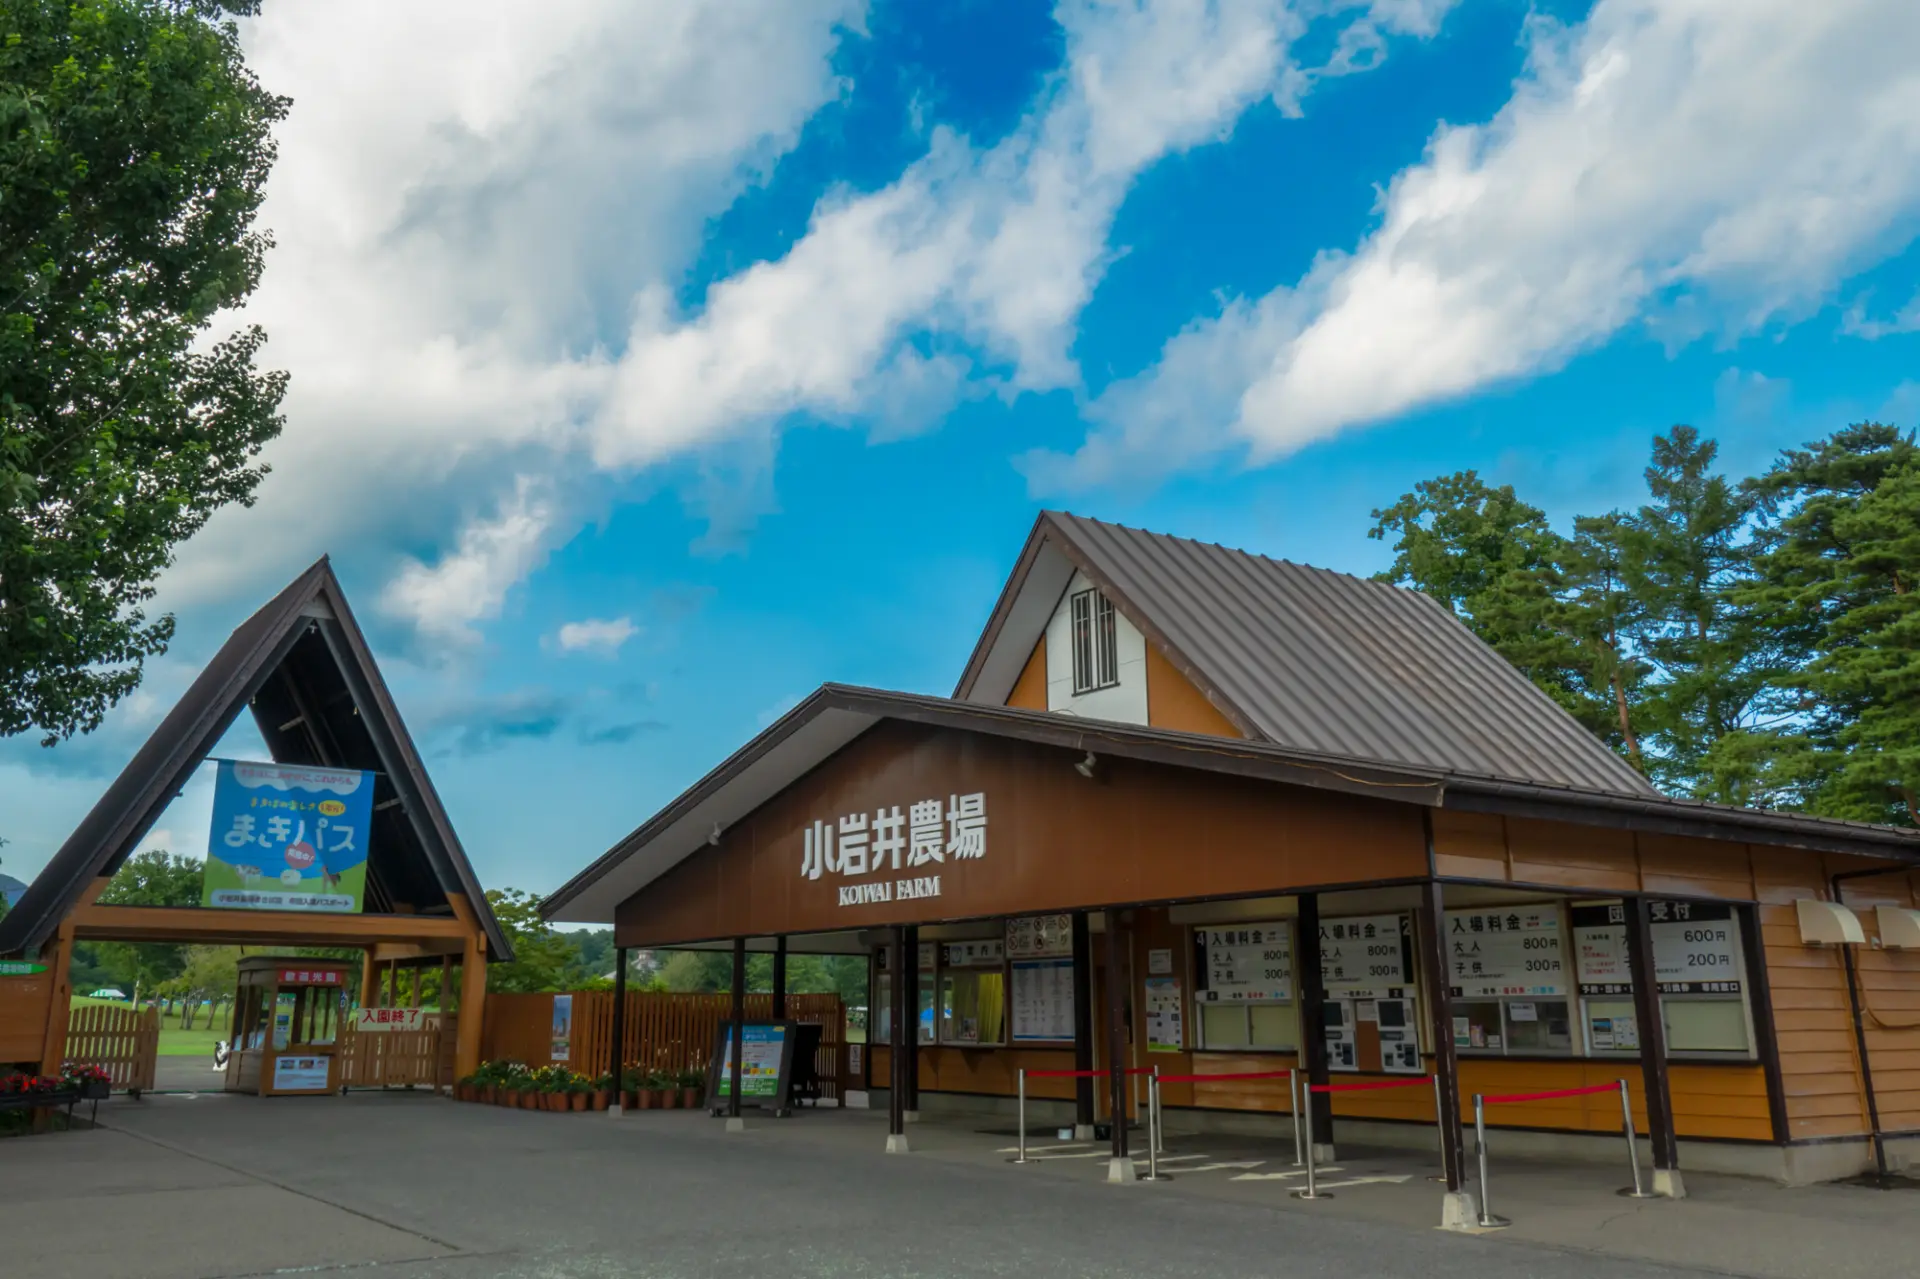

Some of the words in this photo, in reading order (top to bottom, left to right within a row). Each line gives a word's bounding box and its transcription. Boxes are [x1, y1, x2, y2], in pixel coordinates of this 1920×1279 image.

[224, 814, 355, 852] まきパス
[801, 792, 988, 880] 小岩井農場
[839, 882, 892, 907] KOIWAI
[896, 875, 941, 900] FARM
[1608, 902, 1690, 923] 団受付
[1453, 913, 1520, 933] 入場料金
[1197, 932, 1205, 946] 4
[1212, 930, 1262, 945] 入場料金
[1319, 923, 1376, 940] 入場料金
[1685, 929, 1726, 942] 600円
[1368, 945, 1397, 956] 800円
[1454, 940, 1481, 952] 大人
[1523, 937, 1558, 949] 800円
[1213, 952, 1233, 962] 大人
[1263, 950, 1290, 960] 800円
[1687, 953, 1729, 966] 200円
[1369, 965, 1399, 976] 300円
[1455, 961, 1482, 974] 子供
[1525, 959, 1560, 971] 300円
[362, 1009, 419, 1024] 入園終了
